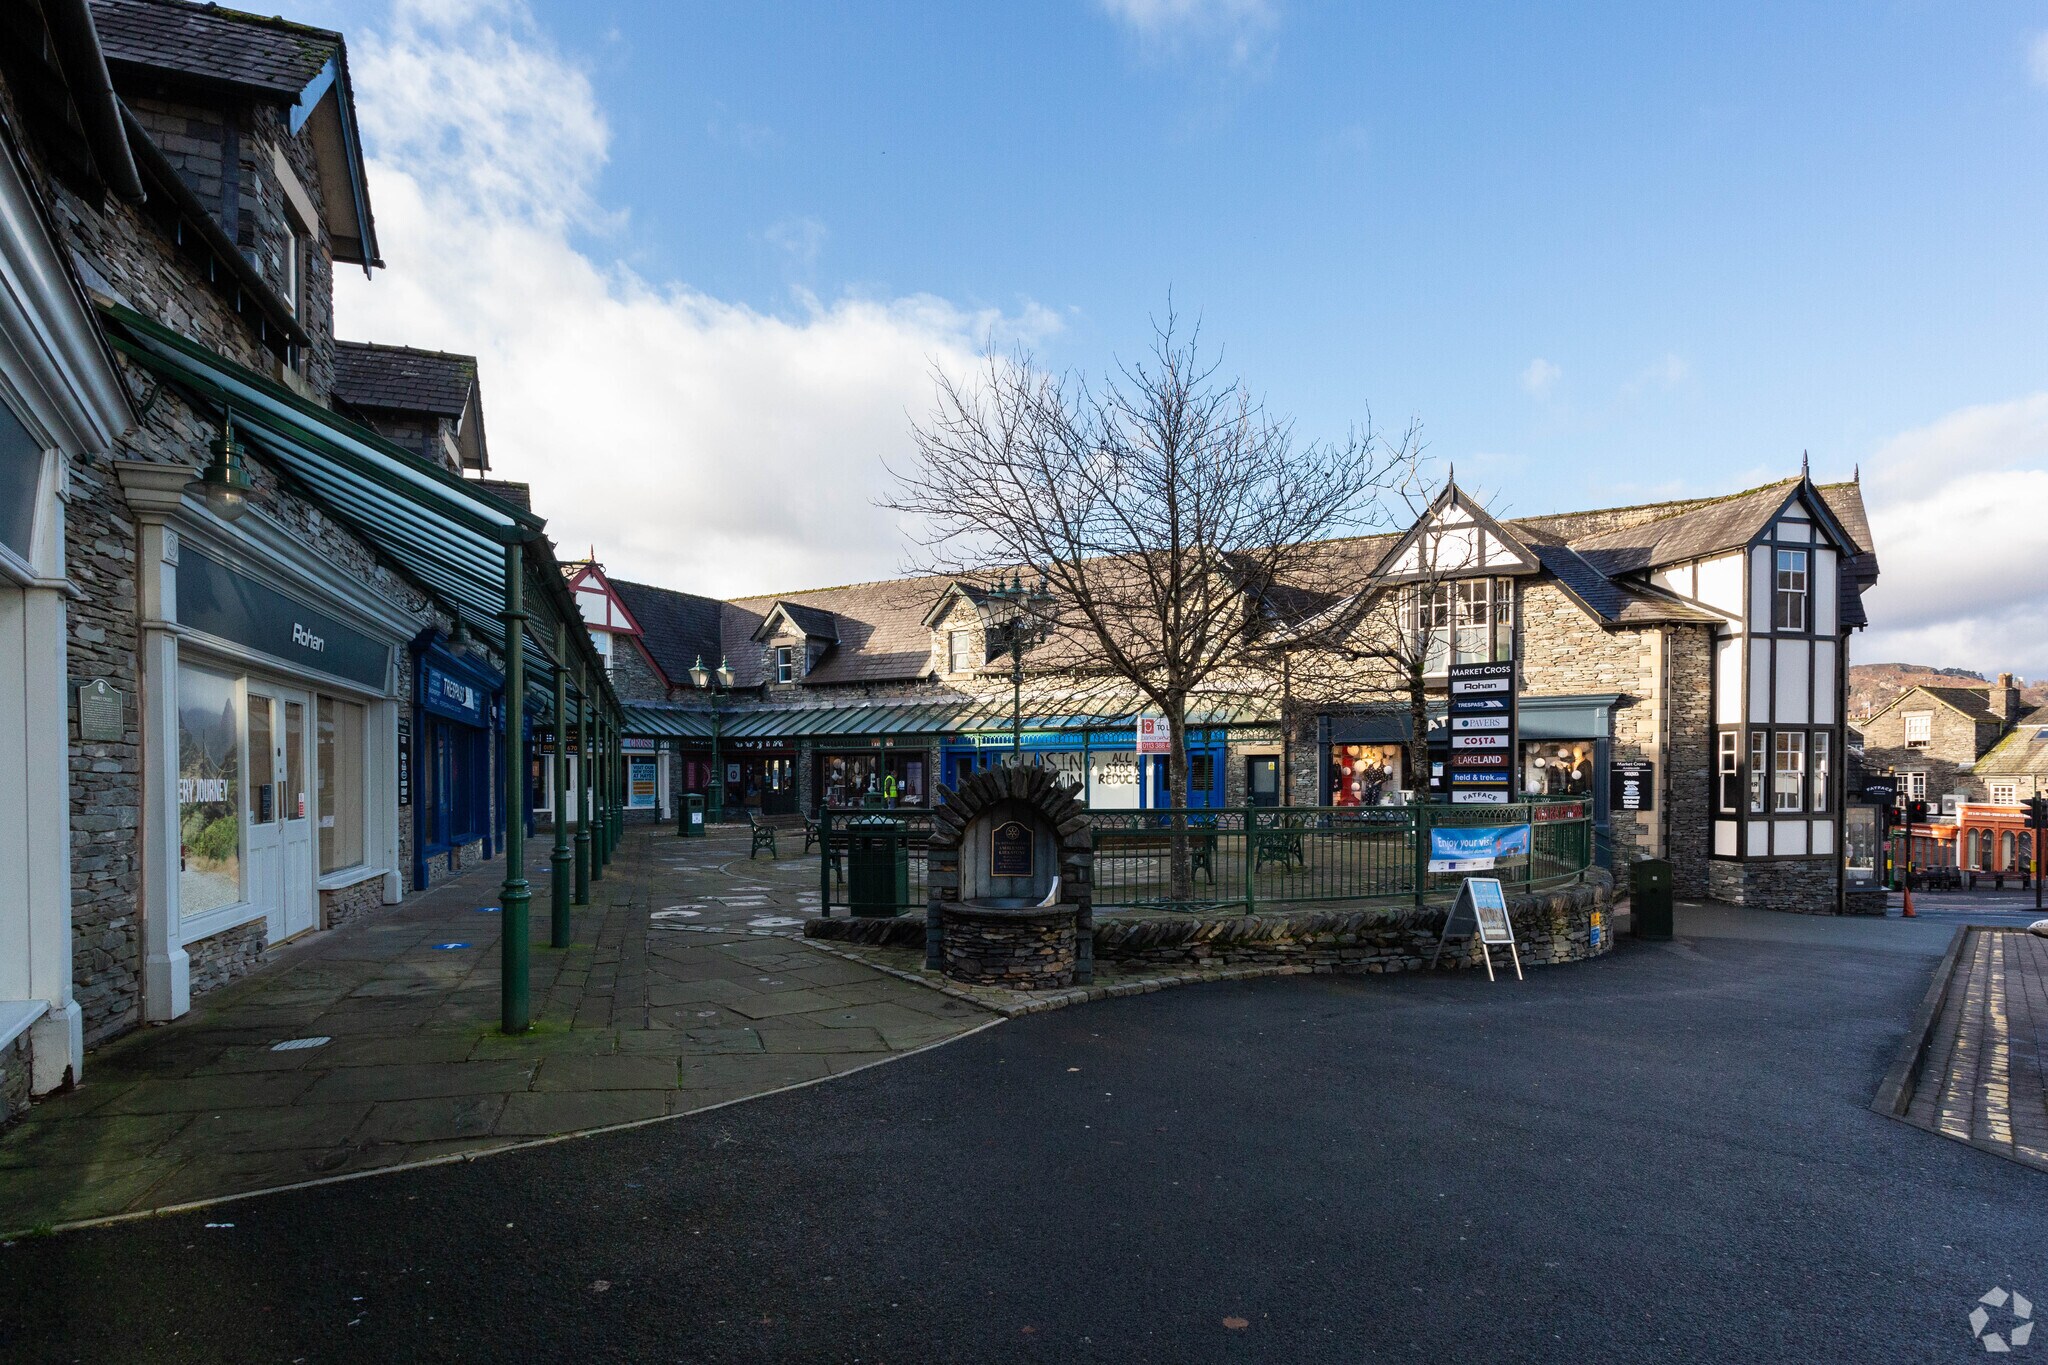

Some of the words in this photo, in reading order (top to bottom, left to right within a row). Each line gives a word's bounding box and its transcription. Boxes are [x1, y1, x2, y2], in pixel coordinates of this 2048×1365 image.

[292, 622, 325, 652] Rohan
[1451, 667, 1483, 676] MARKET
[1484, 665, 1511, 674] CROSS
[1469, 718, 1500, 727] PAVERS
[1464, 736, 1496, 745] COSTA
[1112, 752, 1133, 763] ALL
[1458, 755, 1502, 765] LAKELAND
[1105, 761, 1140, 774] STOCK
[1098, 773, 1140, 785] REDUCE
[1454, 773, 1471, 781] field
[1472, 773, 1478, 781] &
[1480, 773, 1507, 781] trek.com
[195, 778, 229, 803] JOURNEY
[1866, 785, 1893, 793] FATFACE
[1462, 792, 1498, 801] FATFACE
[1437, 837, 1459, 850] Enjoy
[1459, 839, 1478, 850] your
